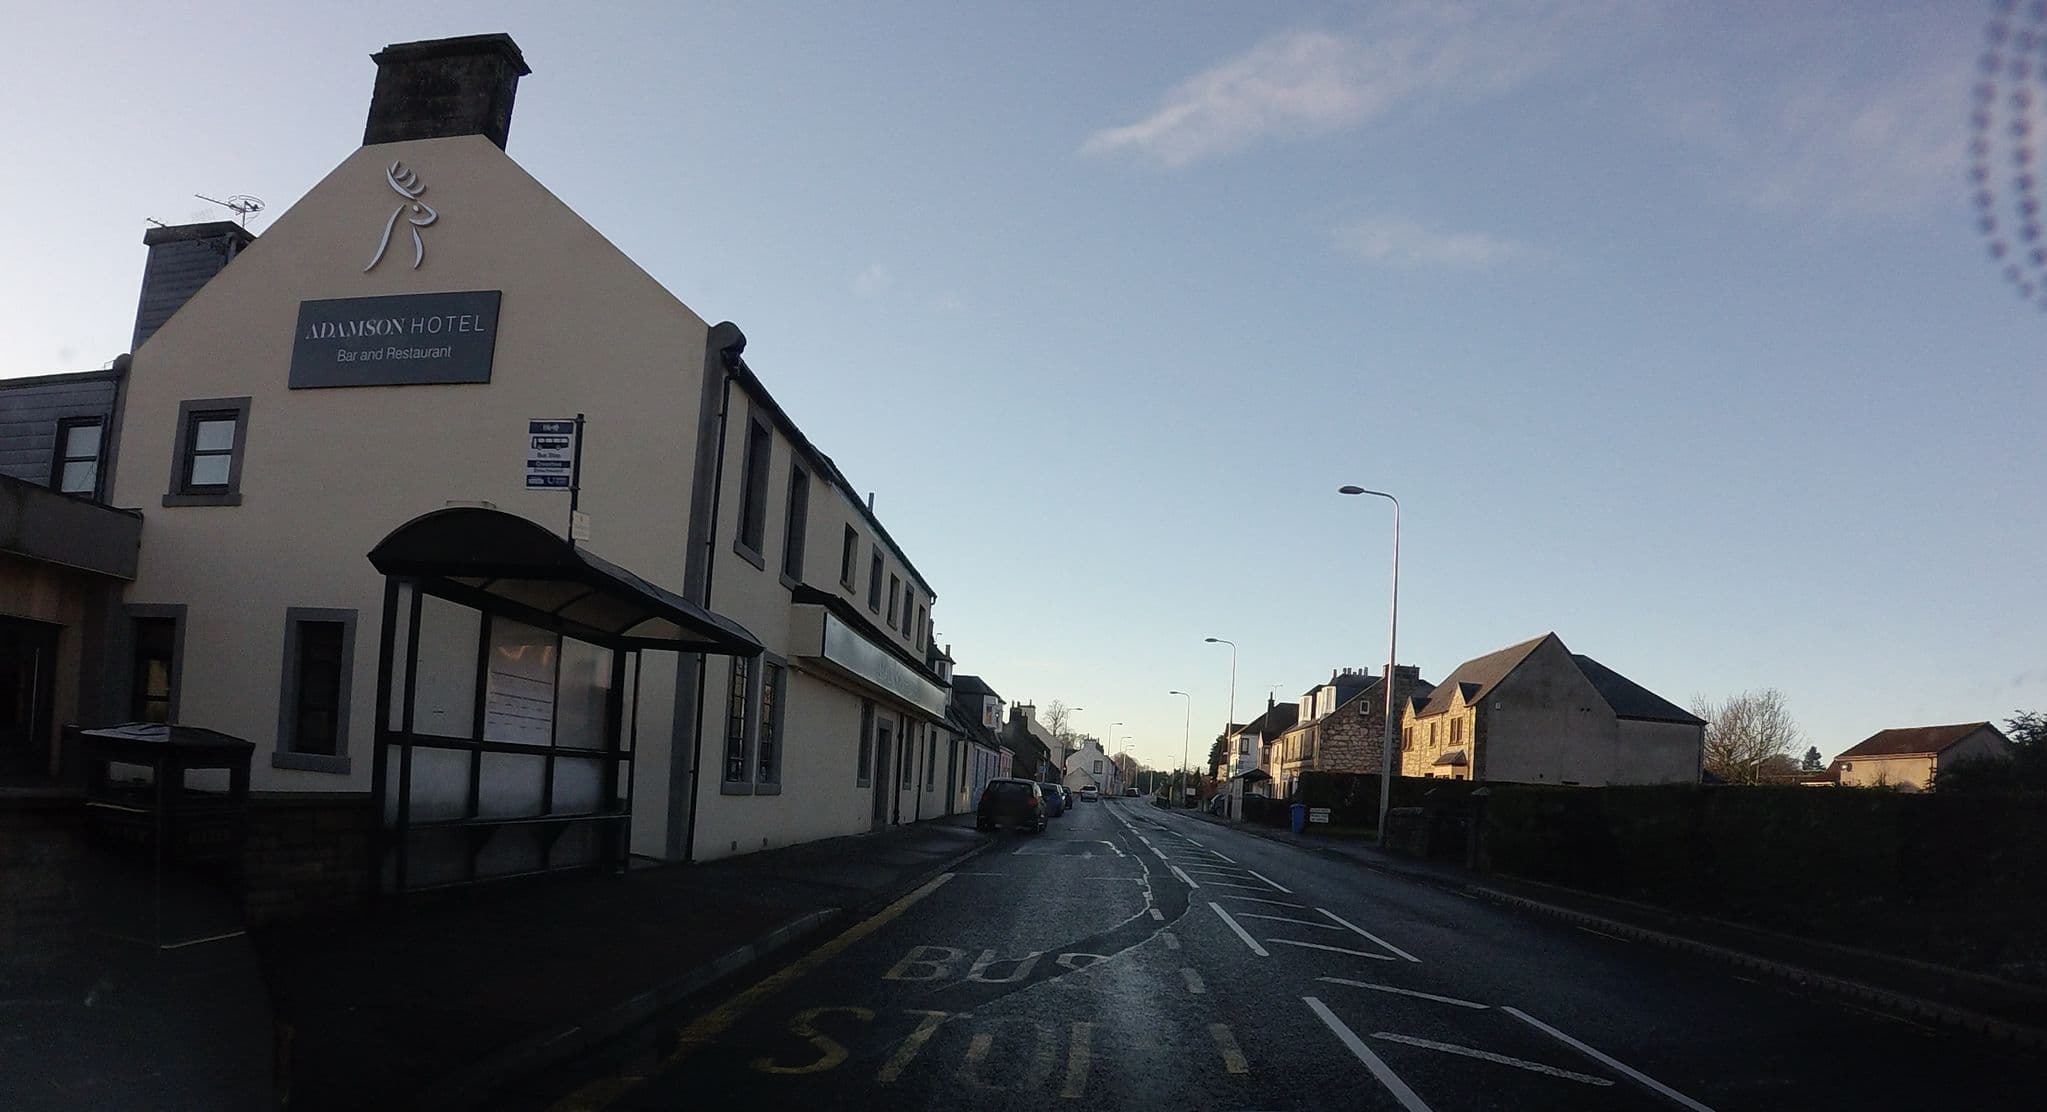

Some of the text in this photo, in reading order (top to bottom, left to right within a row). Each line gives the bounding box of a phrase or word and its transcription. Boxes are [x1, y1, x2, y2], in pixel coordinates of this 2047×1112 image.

[305, 315, 485, 340] ADAMSON HOTEL
[337, 346, 452, 362] Bar and Restaurant
